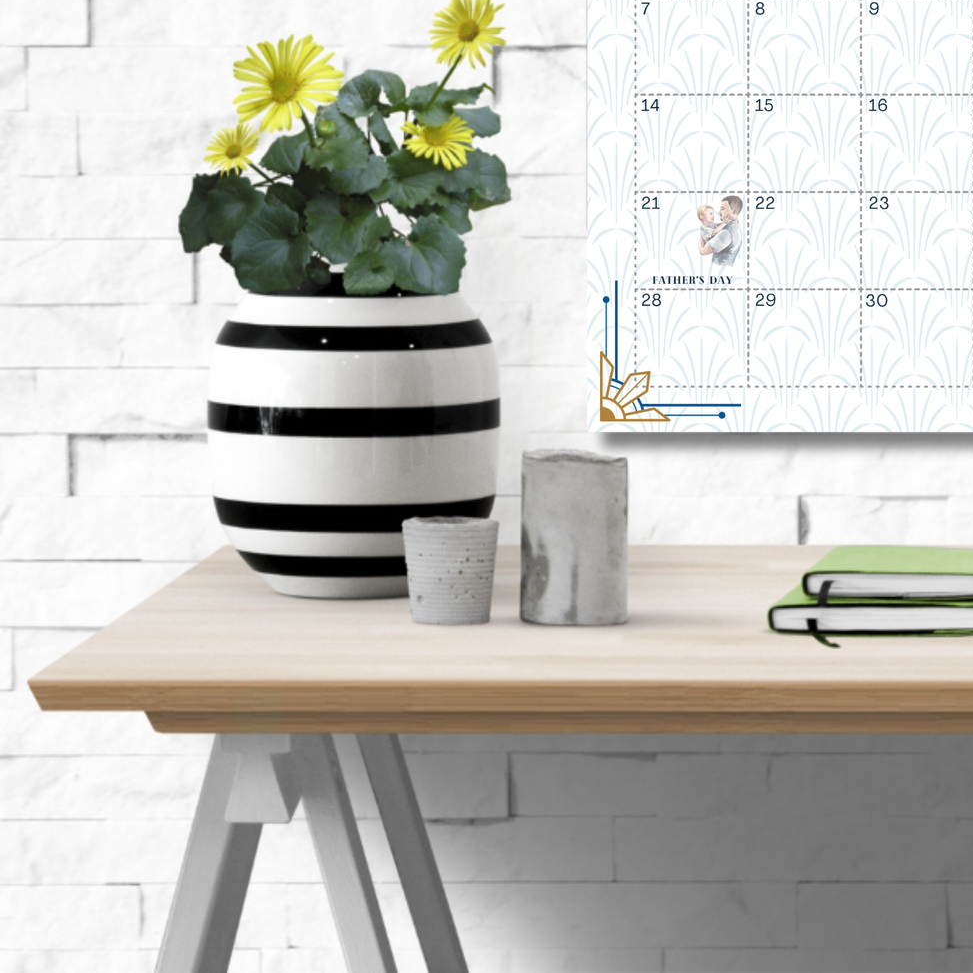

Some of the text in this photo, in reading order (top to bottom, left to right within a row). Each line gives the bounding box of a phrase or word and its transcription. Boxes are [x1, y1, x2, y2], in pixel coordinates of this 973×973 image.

[641, 1, 651, 16] 7
[755, 1, 766, 16] 8
[868, 1, 880, 16] 9
[641, 98, 660, 112] 14
[754, 98, 774, 112] 15
[868, 98, 888, 112] 16
[641, 195, 661, 210] 21
[755, 195, 775, 210] 22
[868, 195, 890, 210] 23
[652, 275, 731, 285] FATHER'S DAY
[641, 292, 662, 307] 28
[755, 292, 777, 307] 29
[865, 293, 888, 308] 30
